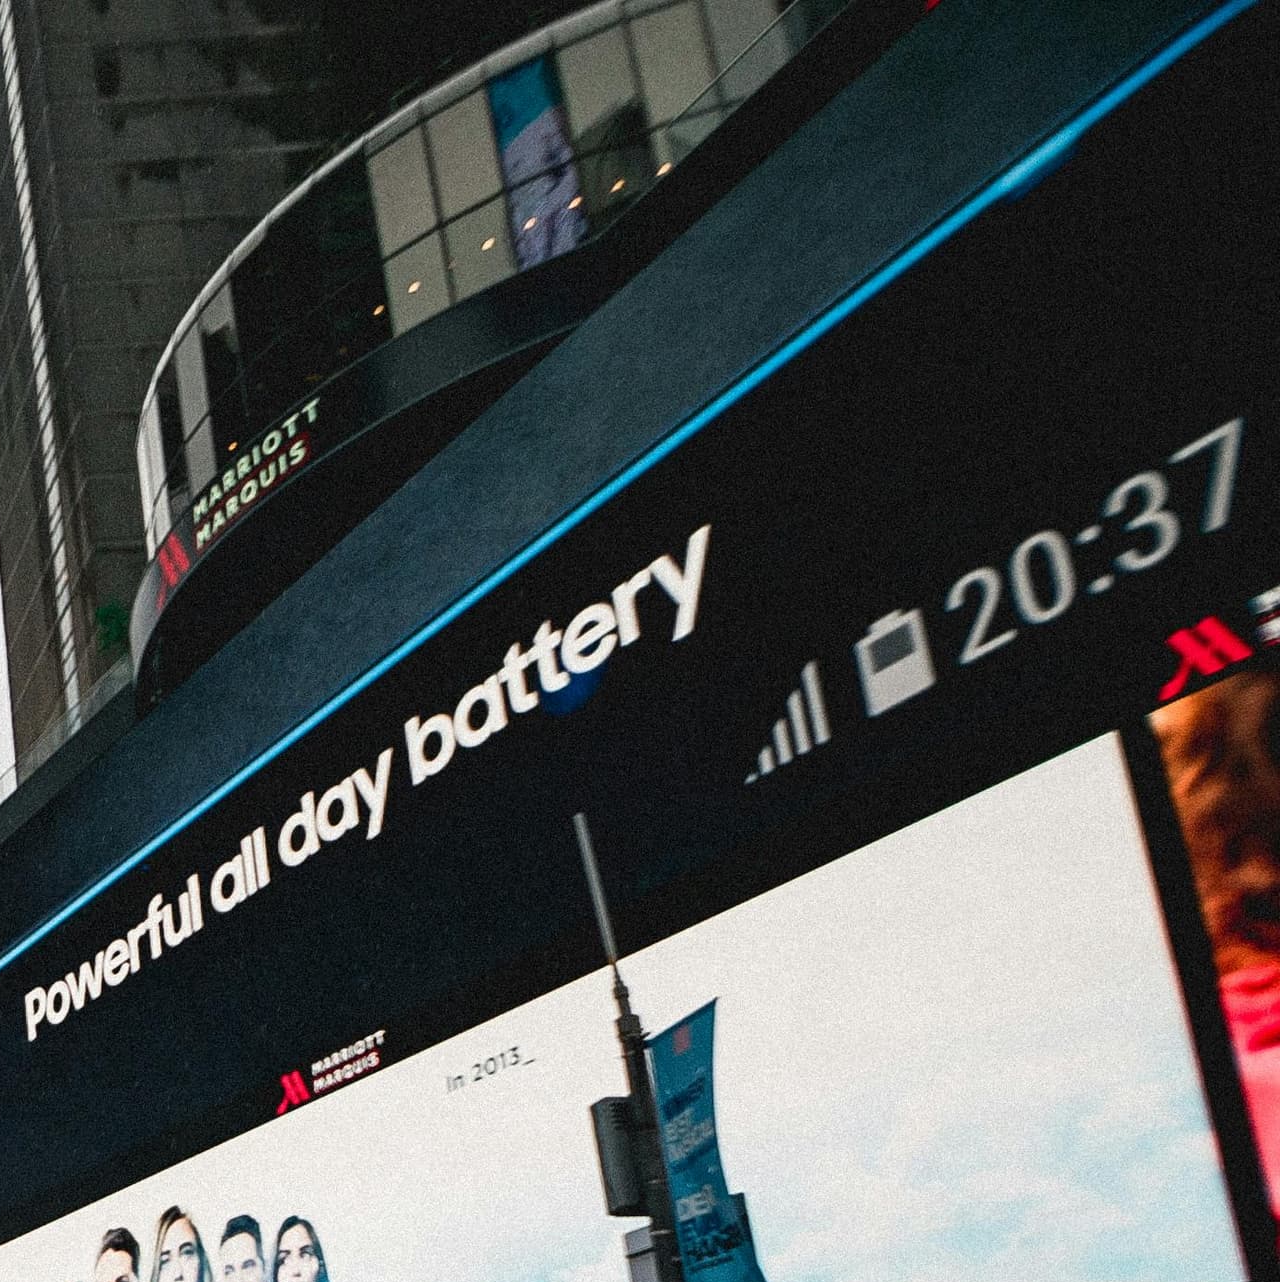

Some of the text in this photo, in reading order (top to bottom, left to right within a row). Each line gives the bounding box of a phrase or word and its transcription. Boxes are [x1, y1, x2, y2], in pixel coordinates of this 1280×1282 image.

[193, 397, 320, 523] MARRIOTT
[195, 439, 307, 549] MARQUIS
[945, 416, 1243, 665] 20:37
[24, 524, 713, 1042] Powerful all day battery
[312, 1030, 386, 1075] MARRIOTT
[313, 1051, 380, 1093] MARQUIS
